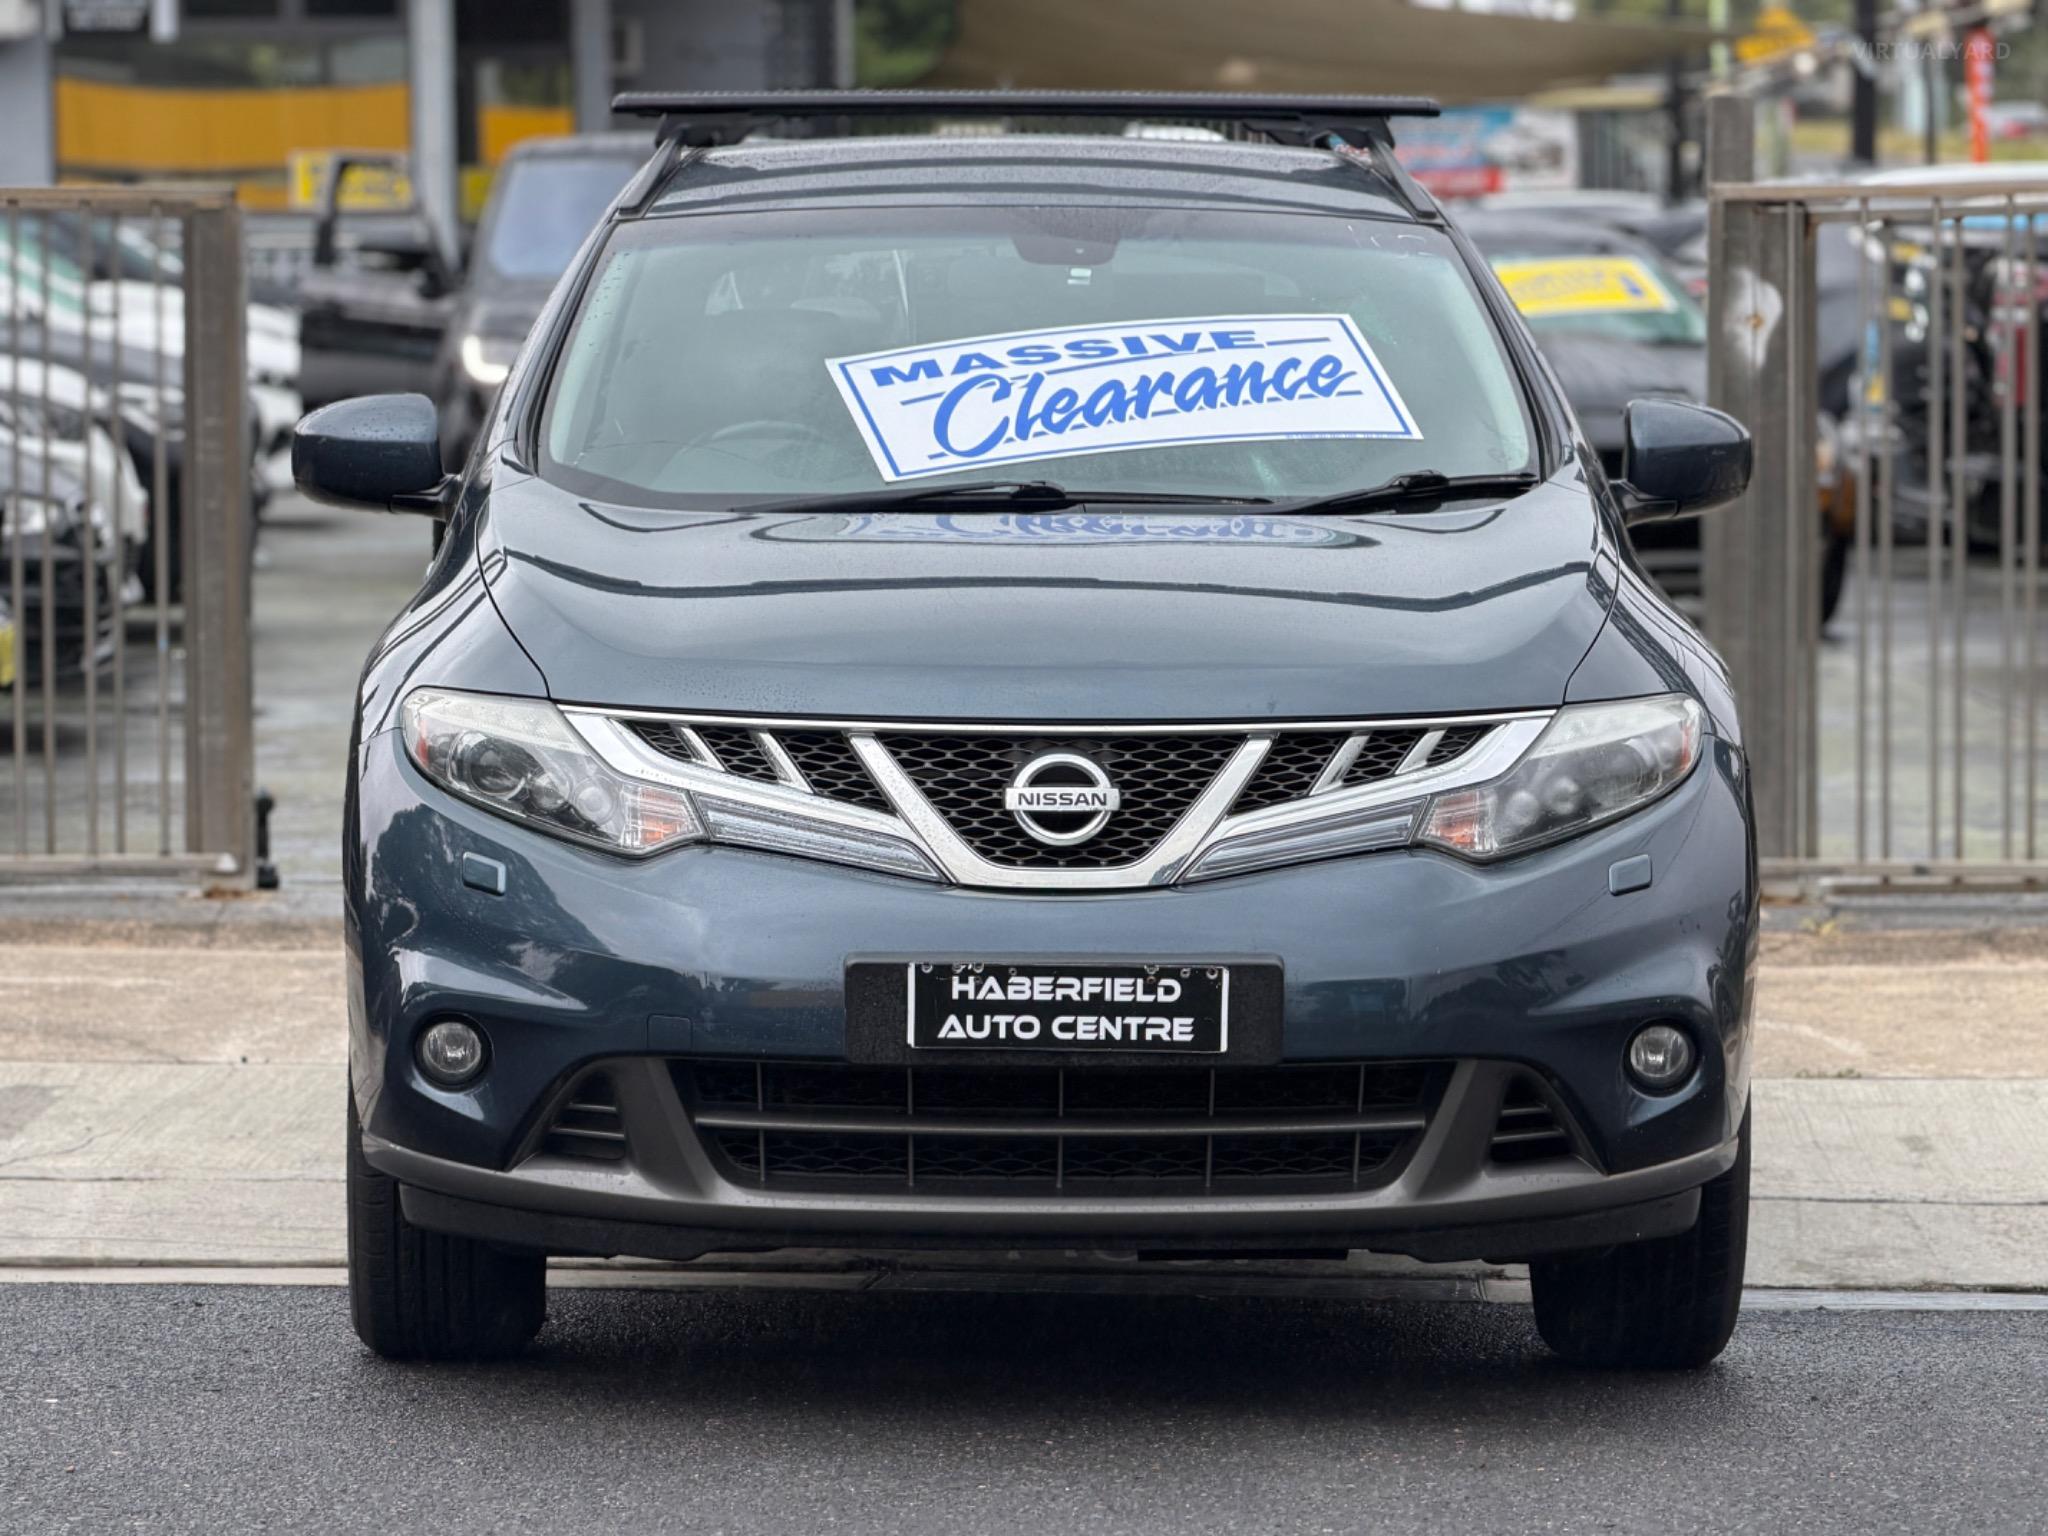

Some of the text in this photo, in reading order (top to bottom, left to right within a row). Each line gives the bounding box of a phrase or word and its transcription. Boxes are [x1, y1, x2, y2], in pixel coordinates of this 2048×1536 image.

[870, 330, 1257, 387] MASSIVE
[932, 352, 1358, 458] Clearance
[1017, 792, 1107, 806] NISSAN
[951, 975, 1182, 1003] HABERFIELD
[937, 1014, 1195, 1042] AUTO CENTRE
